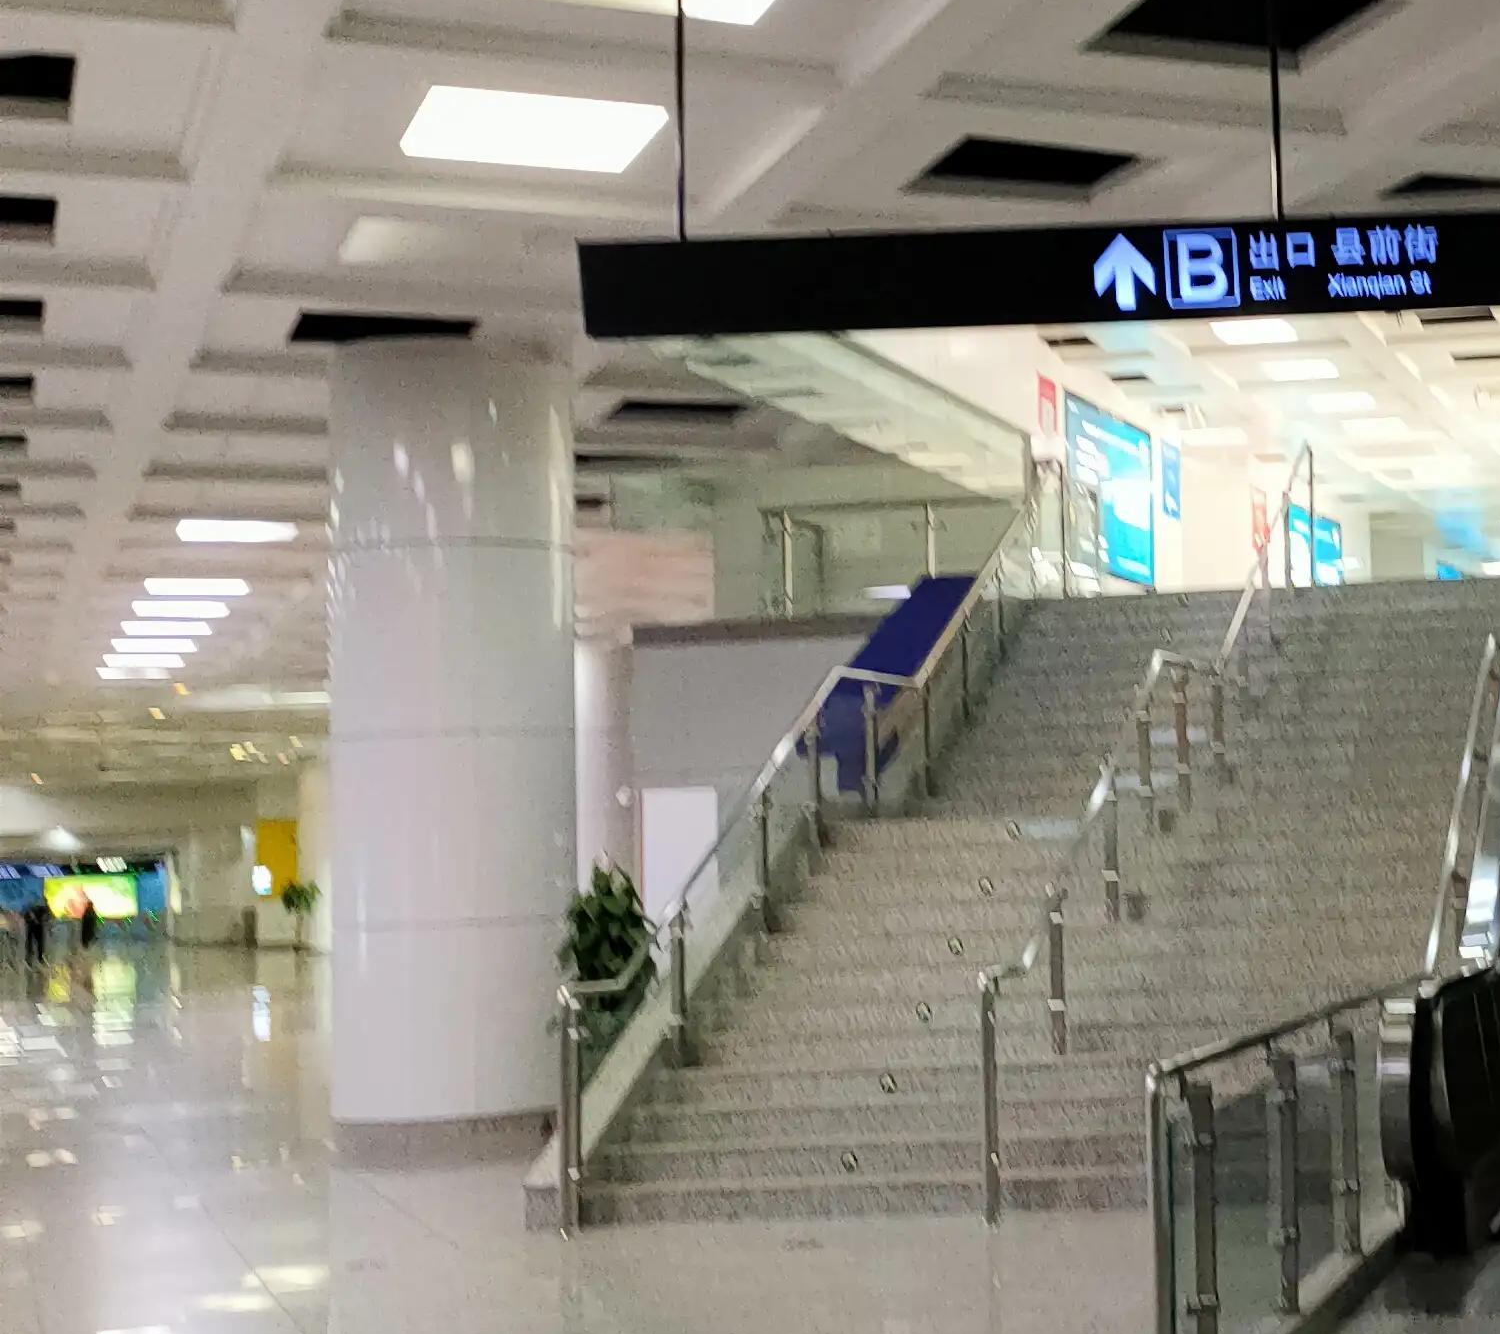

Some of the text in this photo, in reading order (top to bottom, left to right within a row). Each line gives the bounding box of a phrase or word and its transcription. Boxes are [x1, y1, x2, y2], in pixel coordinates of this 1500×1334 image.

[1176, 233, 1229, 303] B
[1248, 230, 1315, 271] 出口
[1249, 275, 1287, 301] Exit
[1327, 270, 1407, 300] Xianqian
